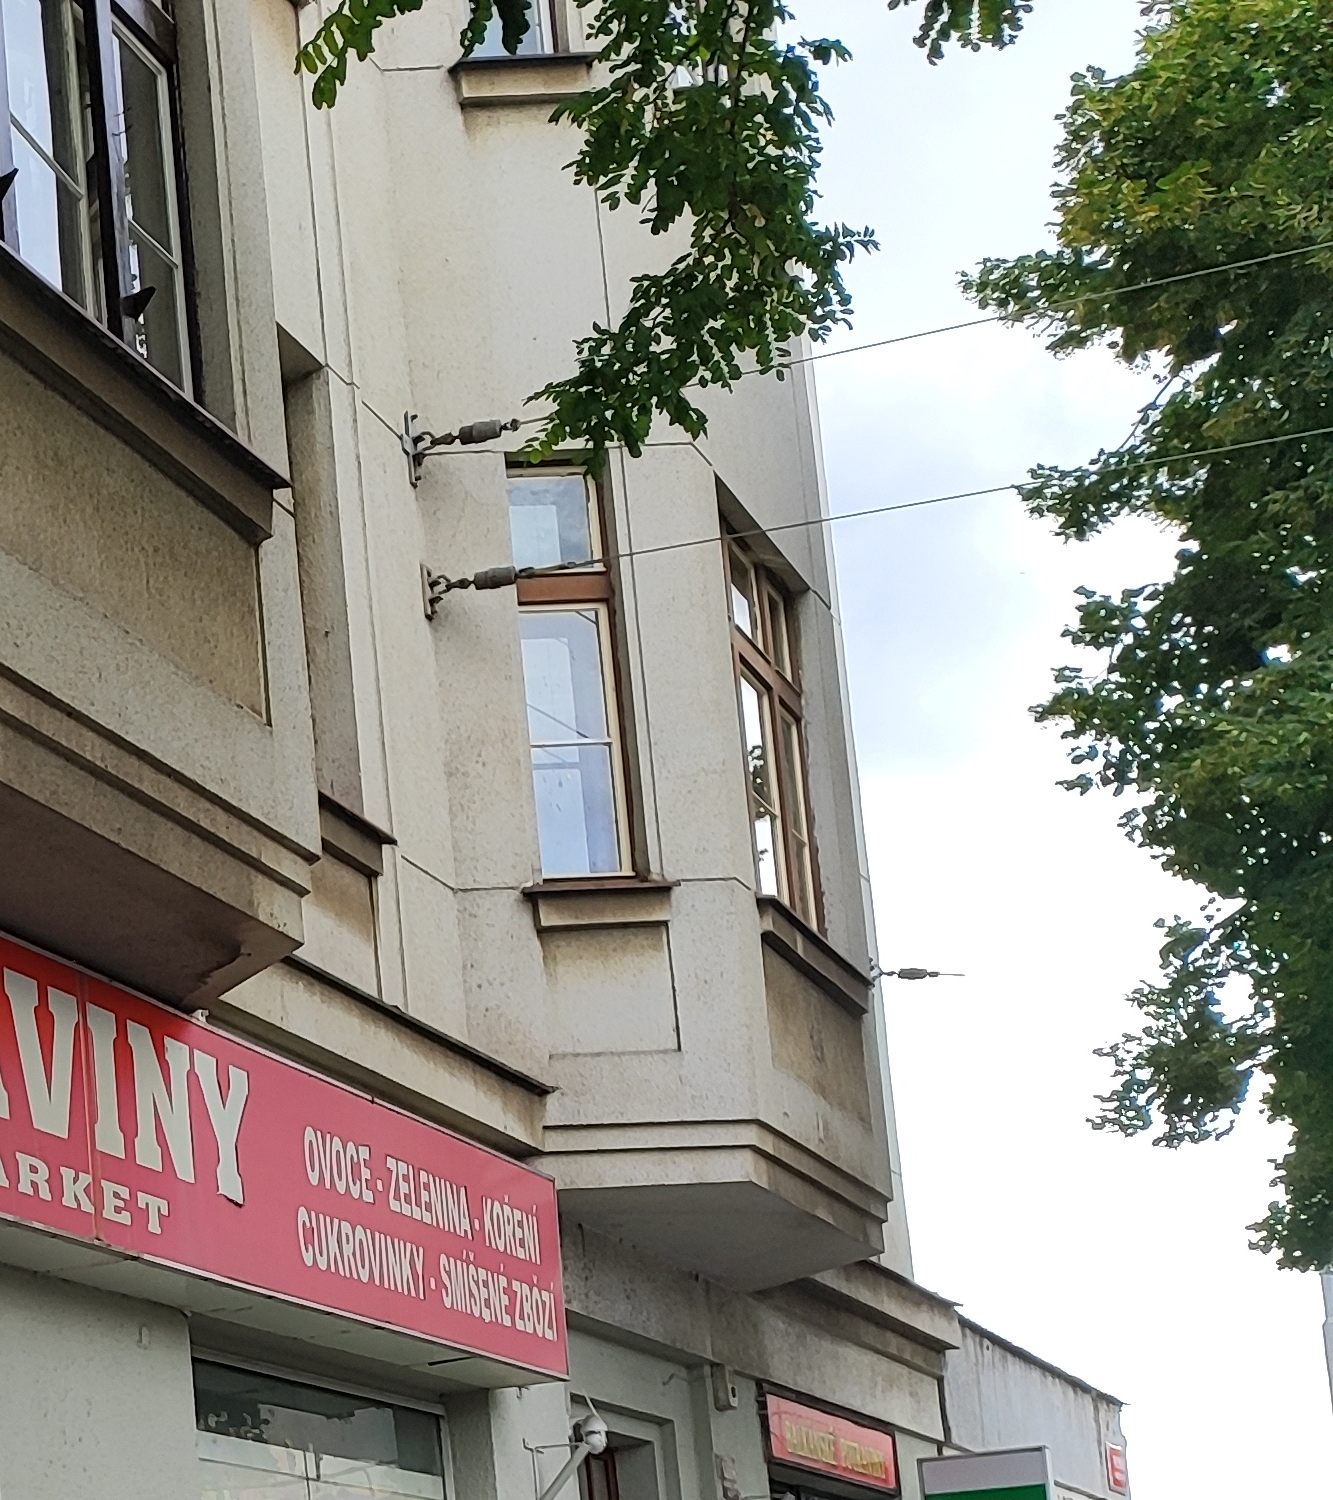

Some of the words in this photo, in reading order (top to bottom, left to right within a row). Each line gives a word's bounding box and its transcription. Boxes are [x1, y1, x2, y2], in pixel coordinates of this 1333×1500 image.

[297, 1206, 425, 1300] CUKROVINKY
[304, 1126, 375, 1204] OVOCE
[386, 1155, 473, 1240] ZELENINA
[482, 1195, 541, 1265] KOŘENÍ
